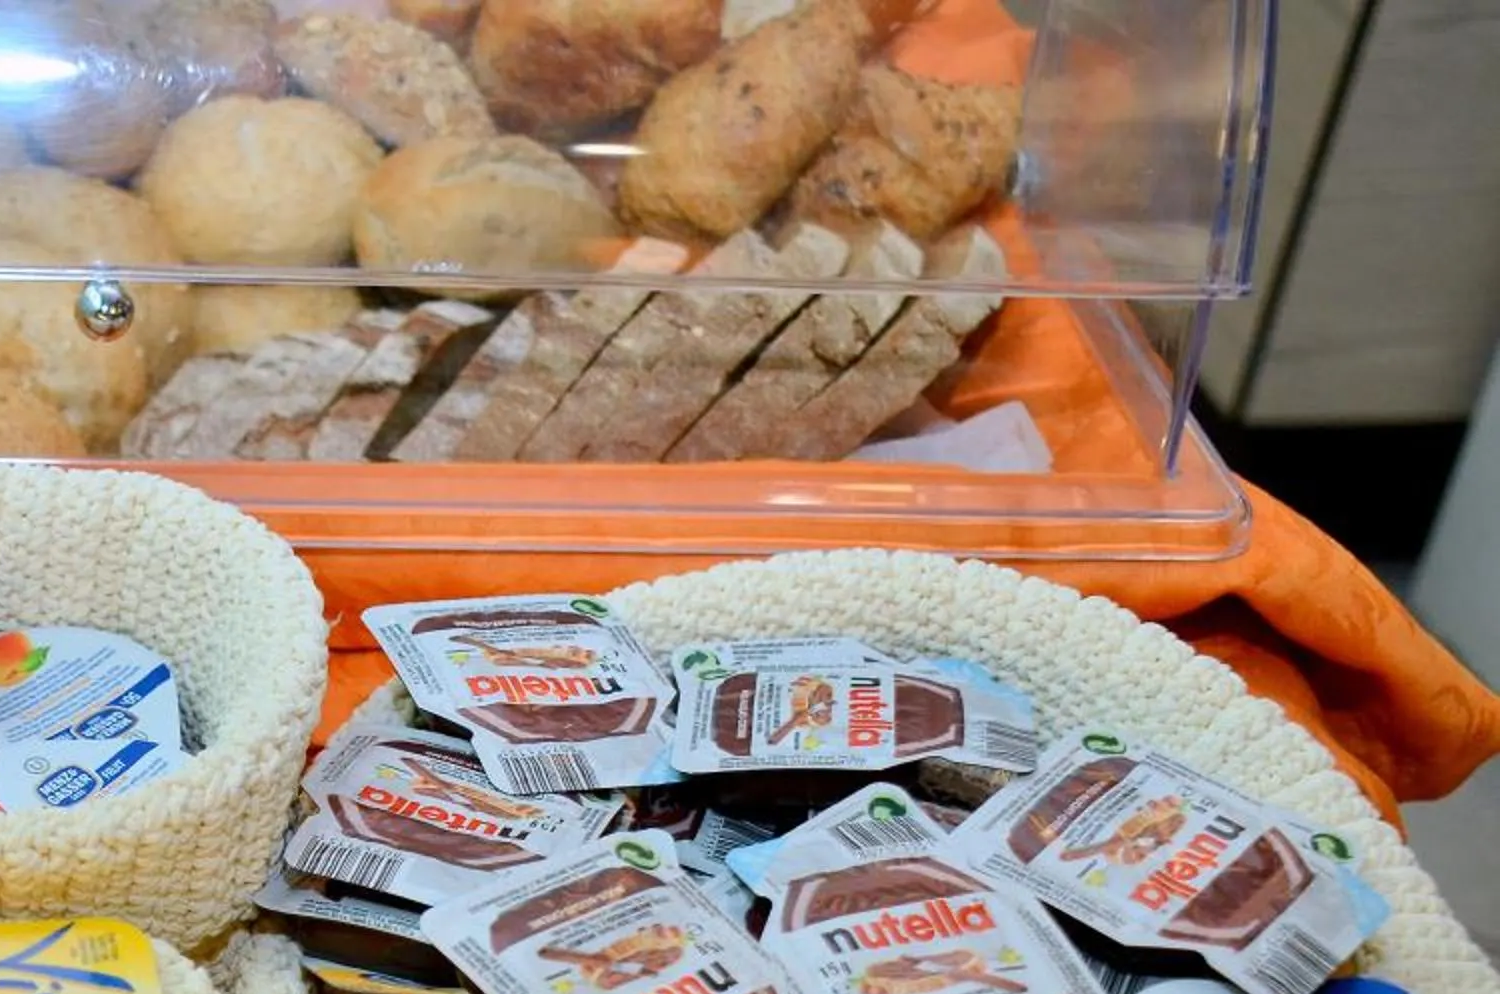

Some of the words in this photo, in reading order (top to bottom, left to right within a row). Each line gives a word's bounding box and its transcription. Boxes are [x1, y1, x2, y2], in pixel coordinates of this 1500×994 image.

[465, 674, 624, 703] nutella
[846, 677, 894, 747] nutella
[47, 773, 92, 806] GASSER
[356, 784, 531, 841] nutella
[1128, 814, 1247, 912] nutella
[820, 896, 997, 954] nutella
